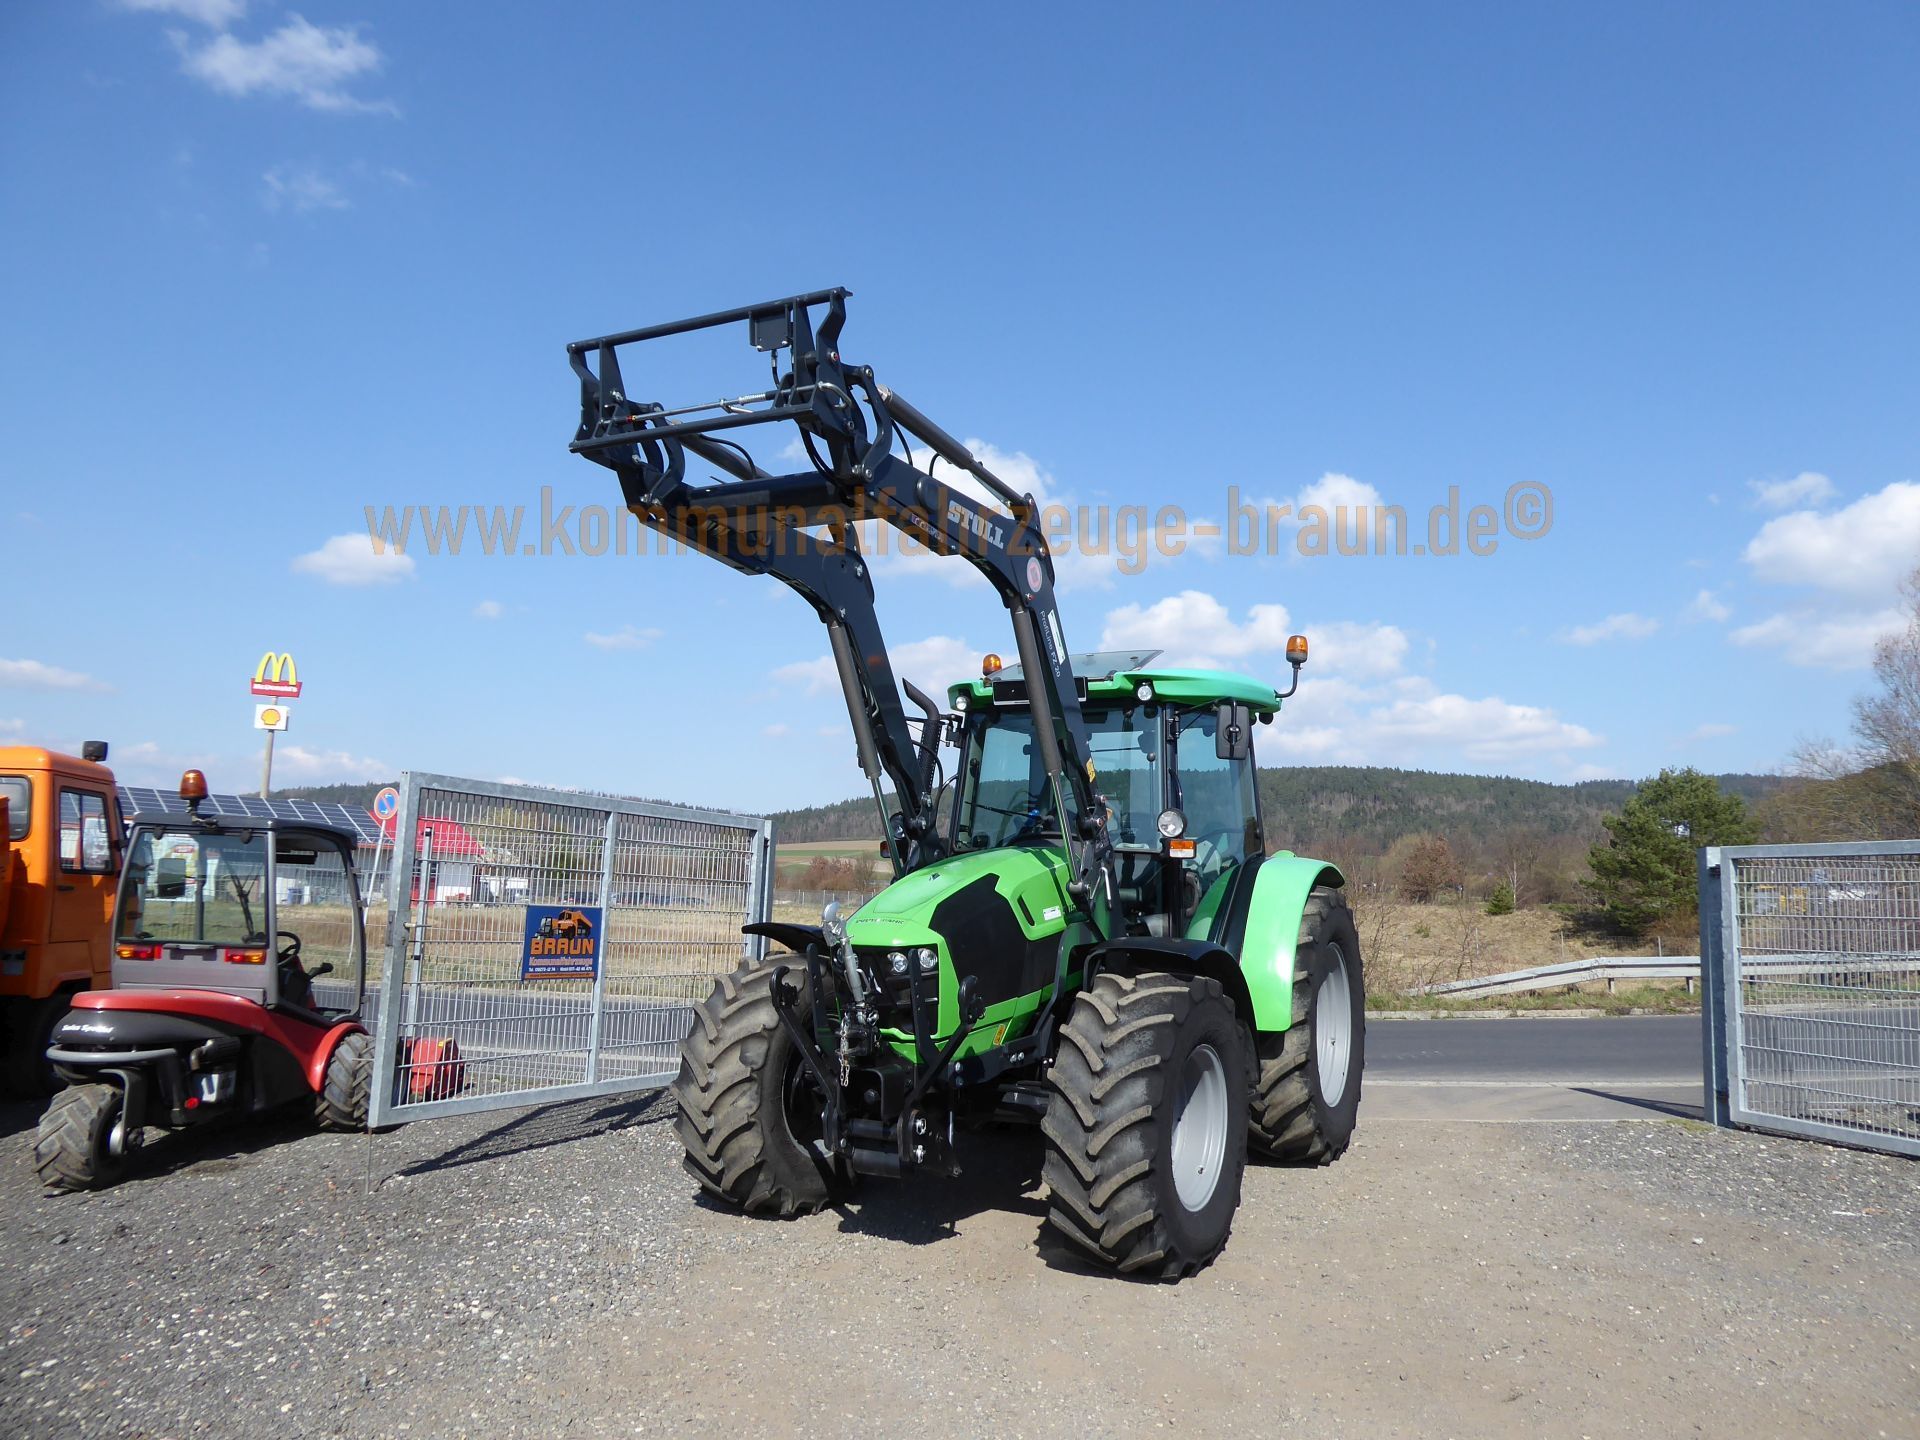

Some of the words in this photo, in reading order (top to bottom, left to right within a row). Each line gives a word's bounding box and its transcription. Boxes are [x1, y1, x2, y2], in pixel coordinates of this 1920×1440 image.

[947, 500, 1004, 550] STOLL
[1040, 610, 1053, 650] ProfiLine
[530, 937, 594, 955] BRAUN
